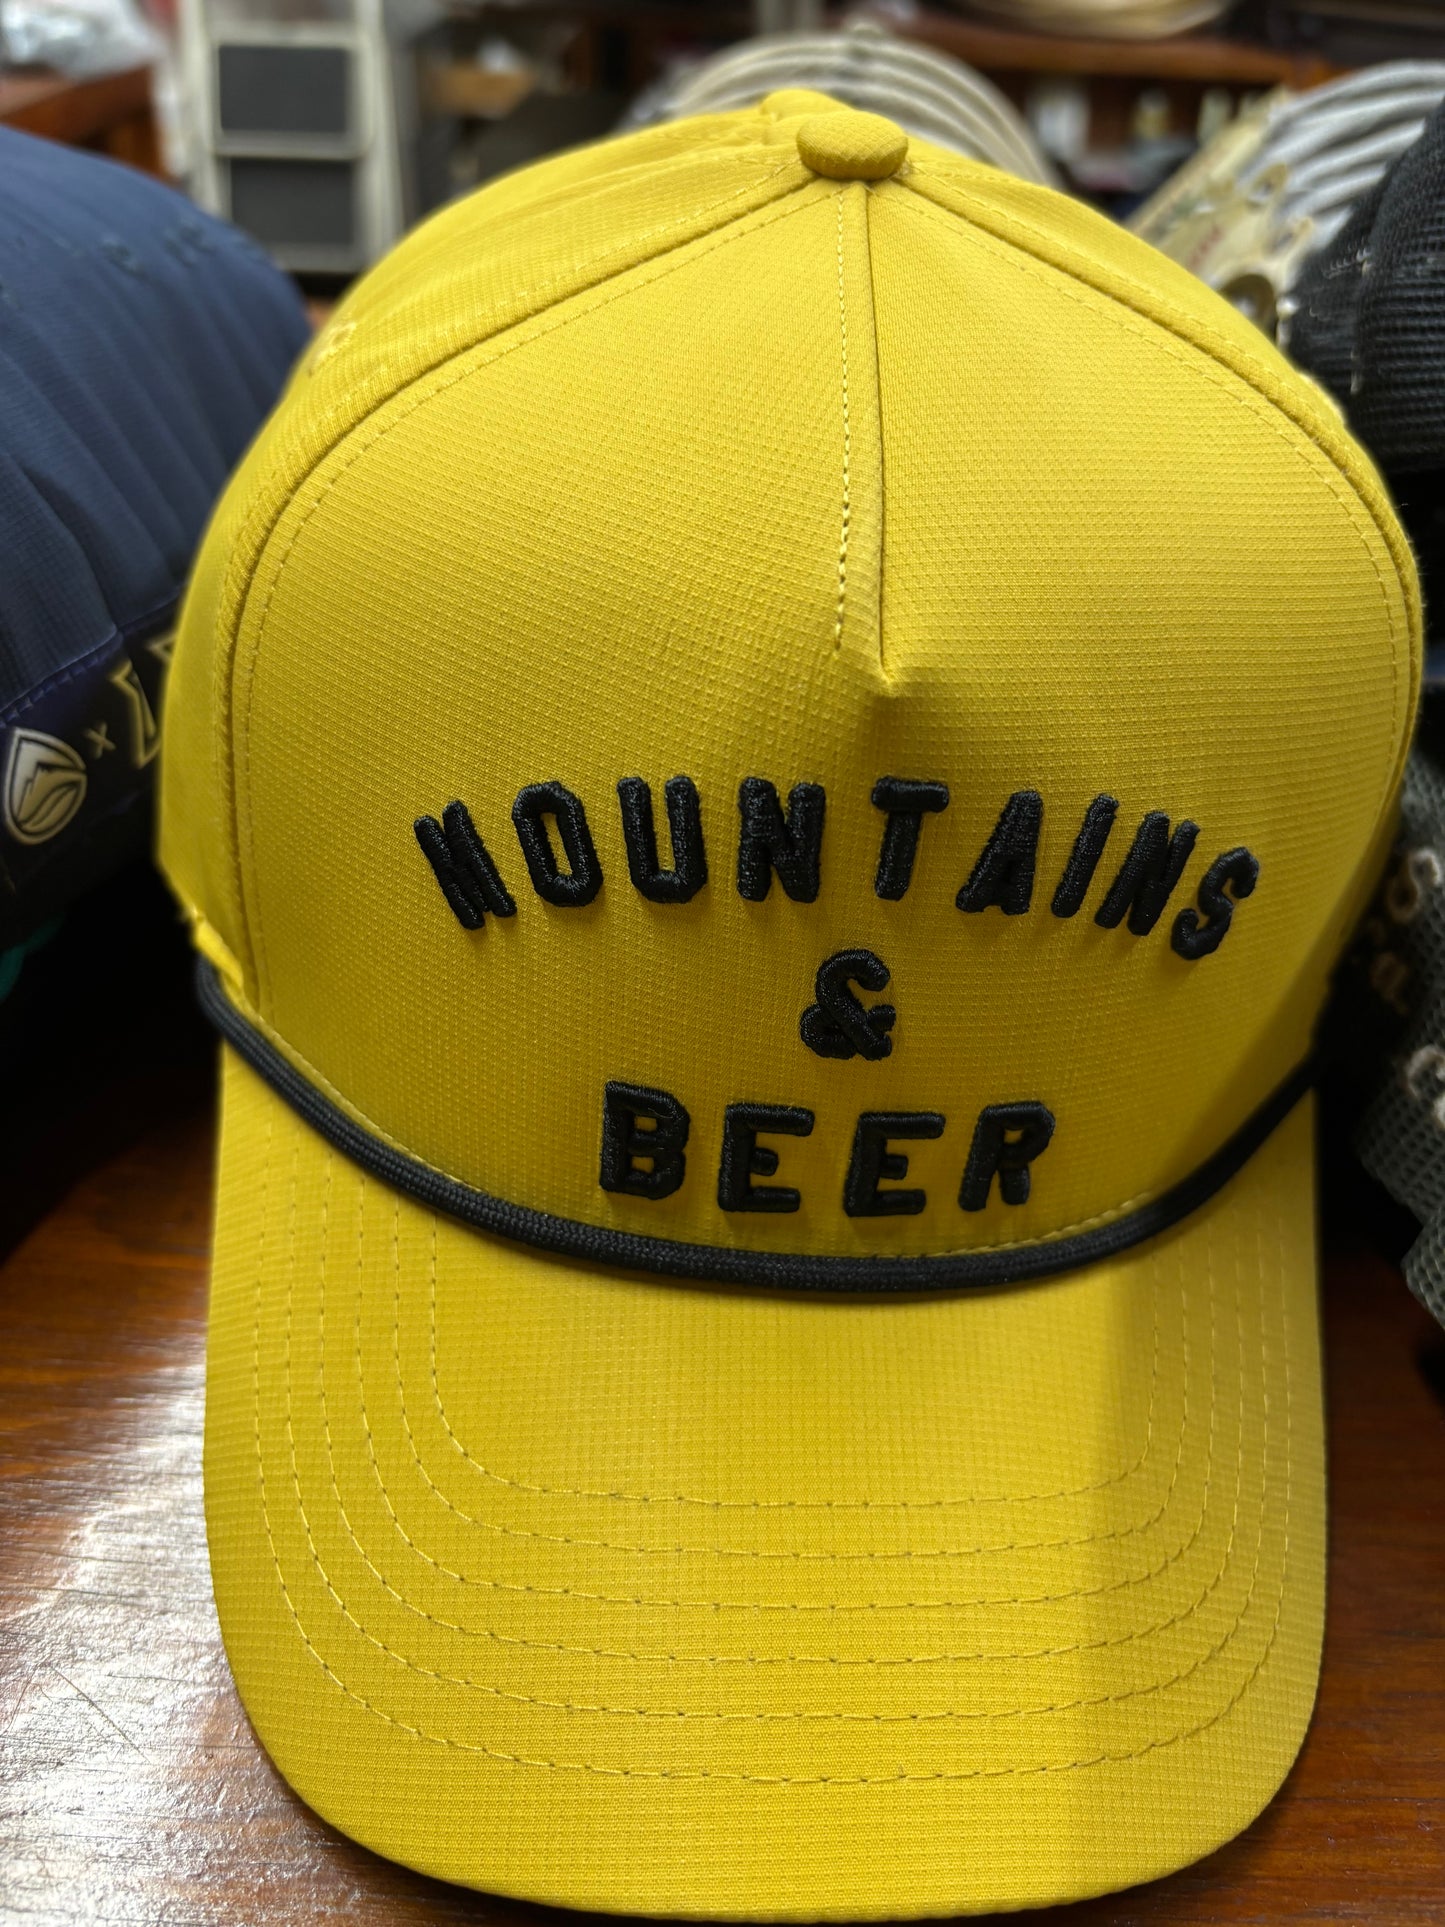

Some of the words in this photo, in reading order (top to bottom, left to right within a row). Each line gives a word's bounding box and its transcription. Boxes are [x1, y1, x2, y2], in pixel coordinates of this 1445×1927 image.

[414, 775, 1259, 961] MOUNTAINS
[799, 948, 897, 1061] &
[599, 1079, 1057, 1217] BEER
